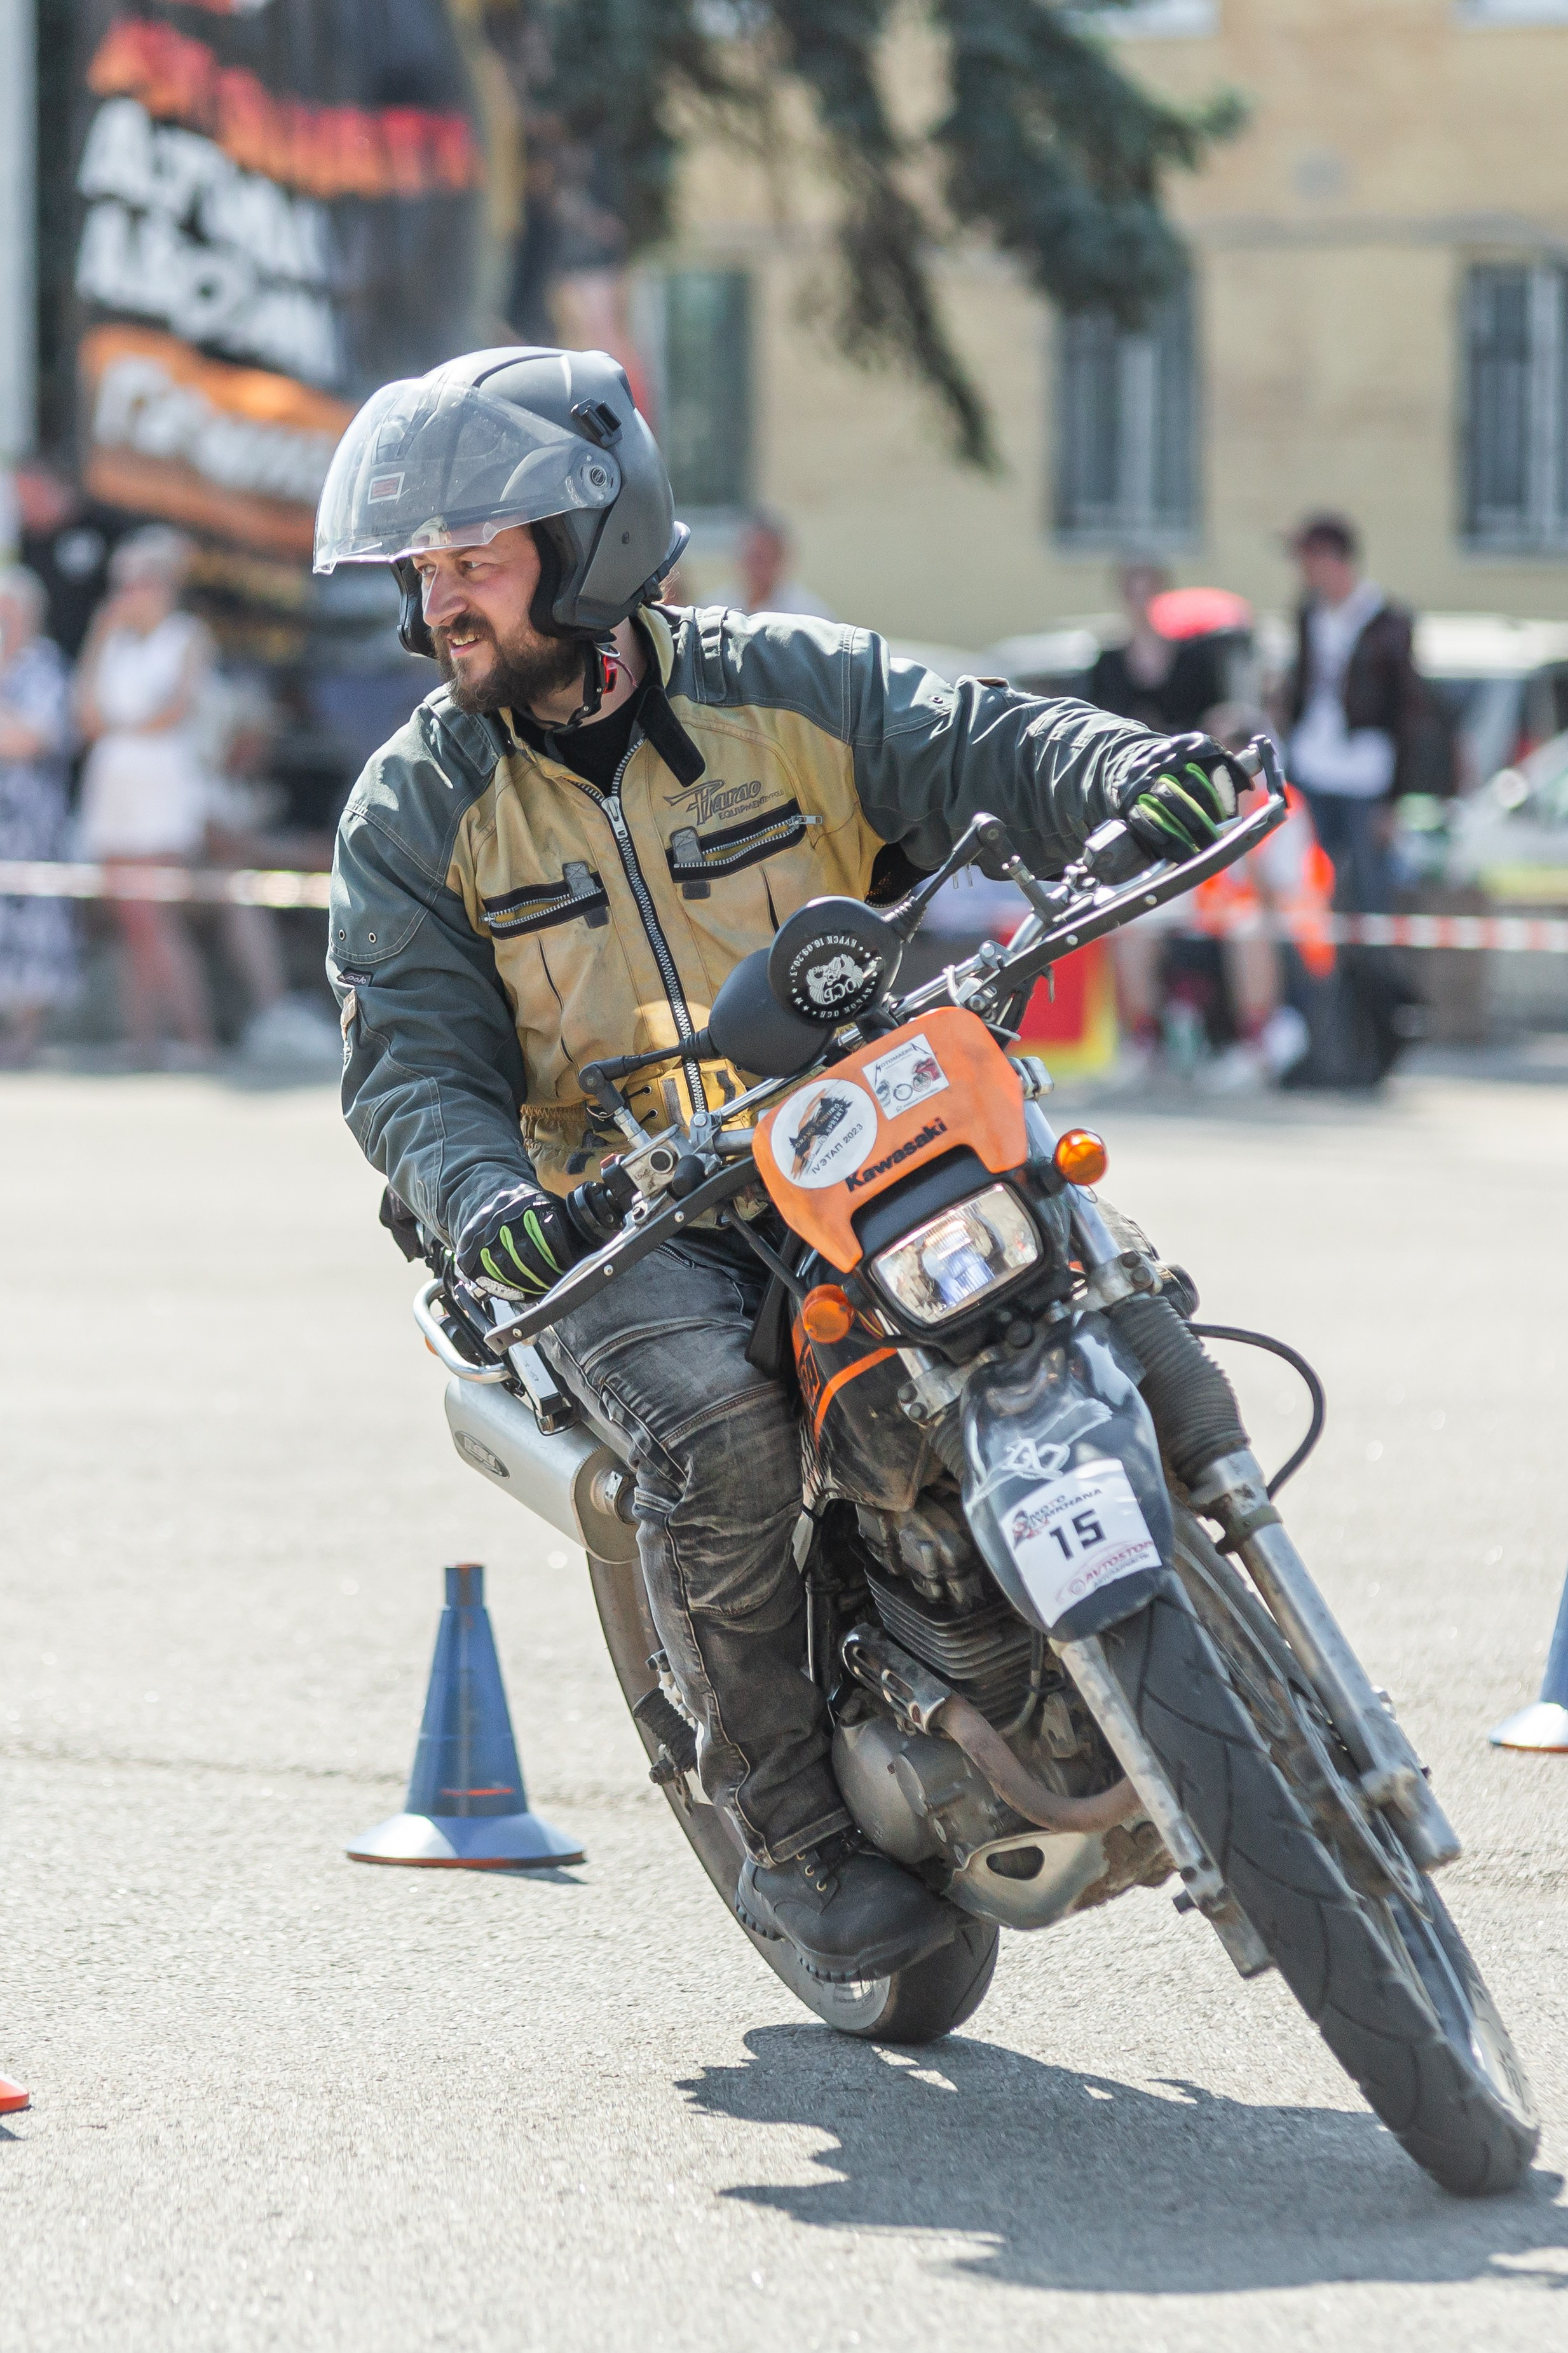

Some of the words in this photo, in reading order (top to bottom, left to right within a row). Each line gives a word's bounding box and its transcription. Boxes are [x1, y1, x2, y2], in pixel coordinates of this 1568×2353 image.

[826, 935, 857, 948] КУРСК
[819, 1142, 844, 1167] ЭТАП
[843, 1123, 863, 1144] 2023
[845, 1117, 948, 1193] Kawasaki
[1049, 1507, 1108, 1561] 15
